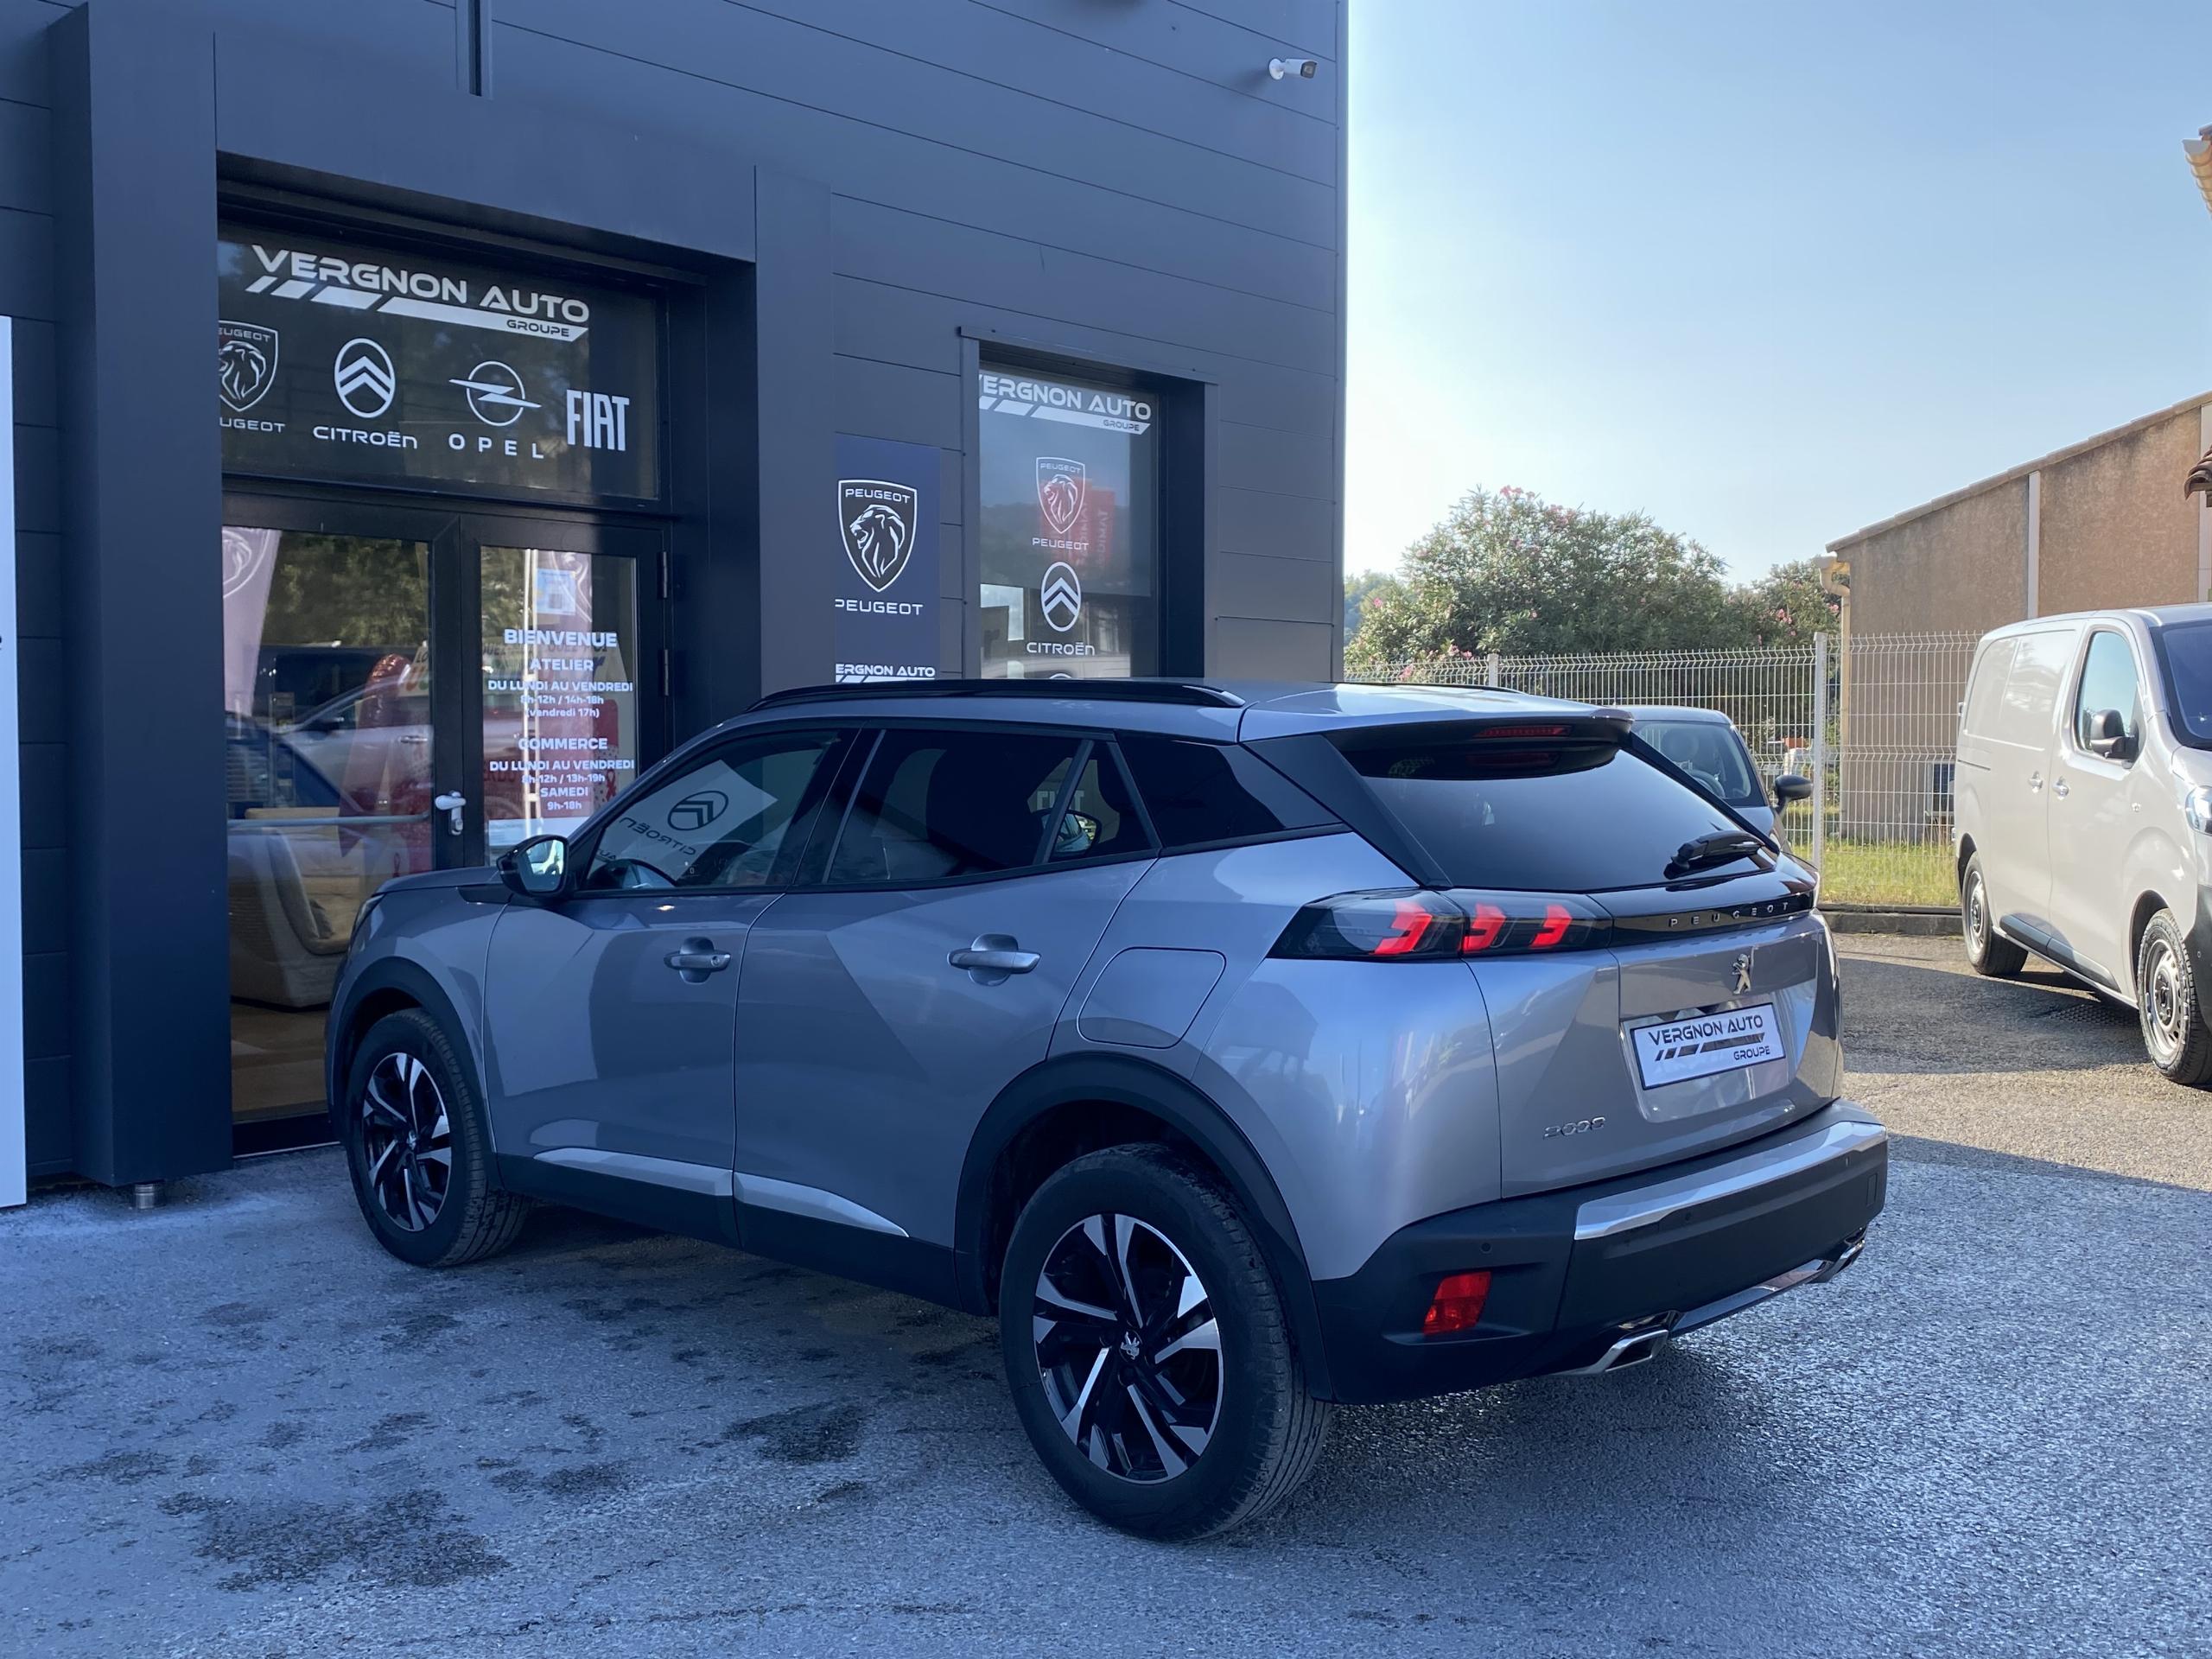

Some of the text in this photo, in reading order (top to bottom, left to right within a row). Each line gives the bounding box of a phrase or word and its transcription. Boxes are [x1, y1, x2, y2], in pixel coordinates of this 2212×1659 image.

[251, 245, 589, 323] VERGNON AUTO
[506, 319, 570, 337] GROUPE
[979, 374, 1152, 420] ERGNON AUTO
[566, 389, 630, 452] FIAT
[1103, 419, 1141, 432] GROUPE
[448, 433, 544, 460] OPEL
[1039, 462, 1082, 474] PEUGEOT
[845, 488, 911, 504] PEUGEOT
[1032, 537, 1090, 550] PEUGEOT
[835, 599, 924, 616] PEUGEOT
[504, 628, 618, 648] BIENVENUE
[530, 658, 594, 671] ATELIER
[896, 665, 936, 677] AUTO
[488, 680, 633, 692] DU LUNDI AU VENDREDI
[520, 695, 556, 705] 8h-12h
[564, 695, 604, 705] 14h-18h
[578, 708, 600, 719] 17h)
[518, 738, 608, 751] COMMERCE
[489, 760, 635, 772] DU LUNDI AU VENDREDI
[566, 773, 606, 784] 13h-19h
[540, 786, 588, 798] SAMEDI
[547, 801, 582, 810] 9h-18h
[1669, 901, 1789, 928] PEUGEOT
[1648, 1014, 1764, 1046] VERGNON AUTO
[1733, 1045, 1770, 1061] GROUPE
[1542, 1116, 1605, 1139] 2008
